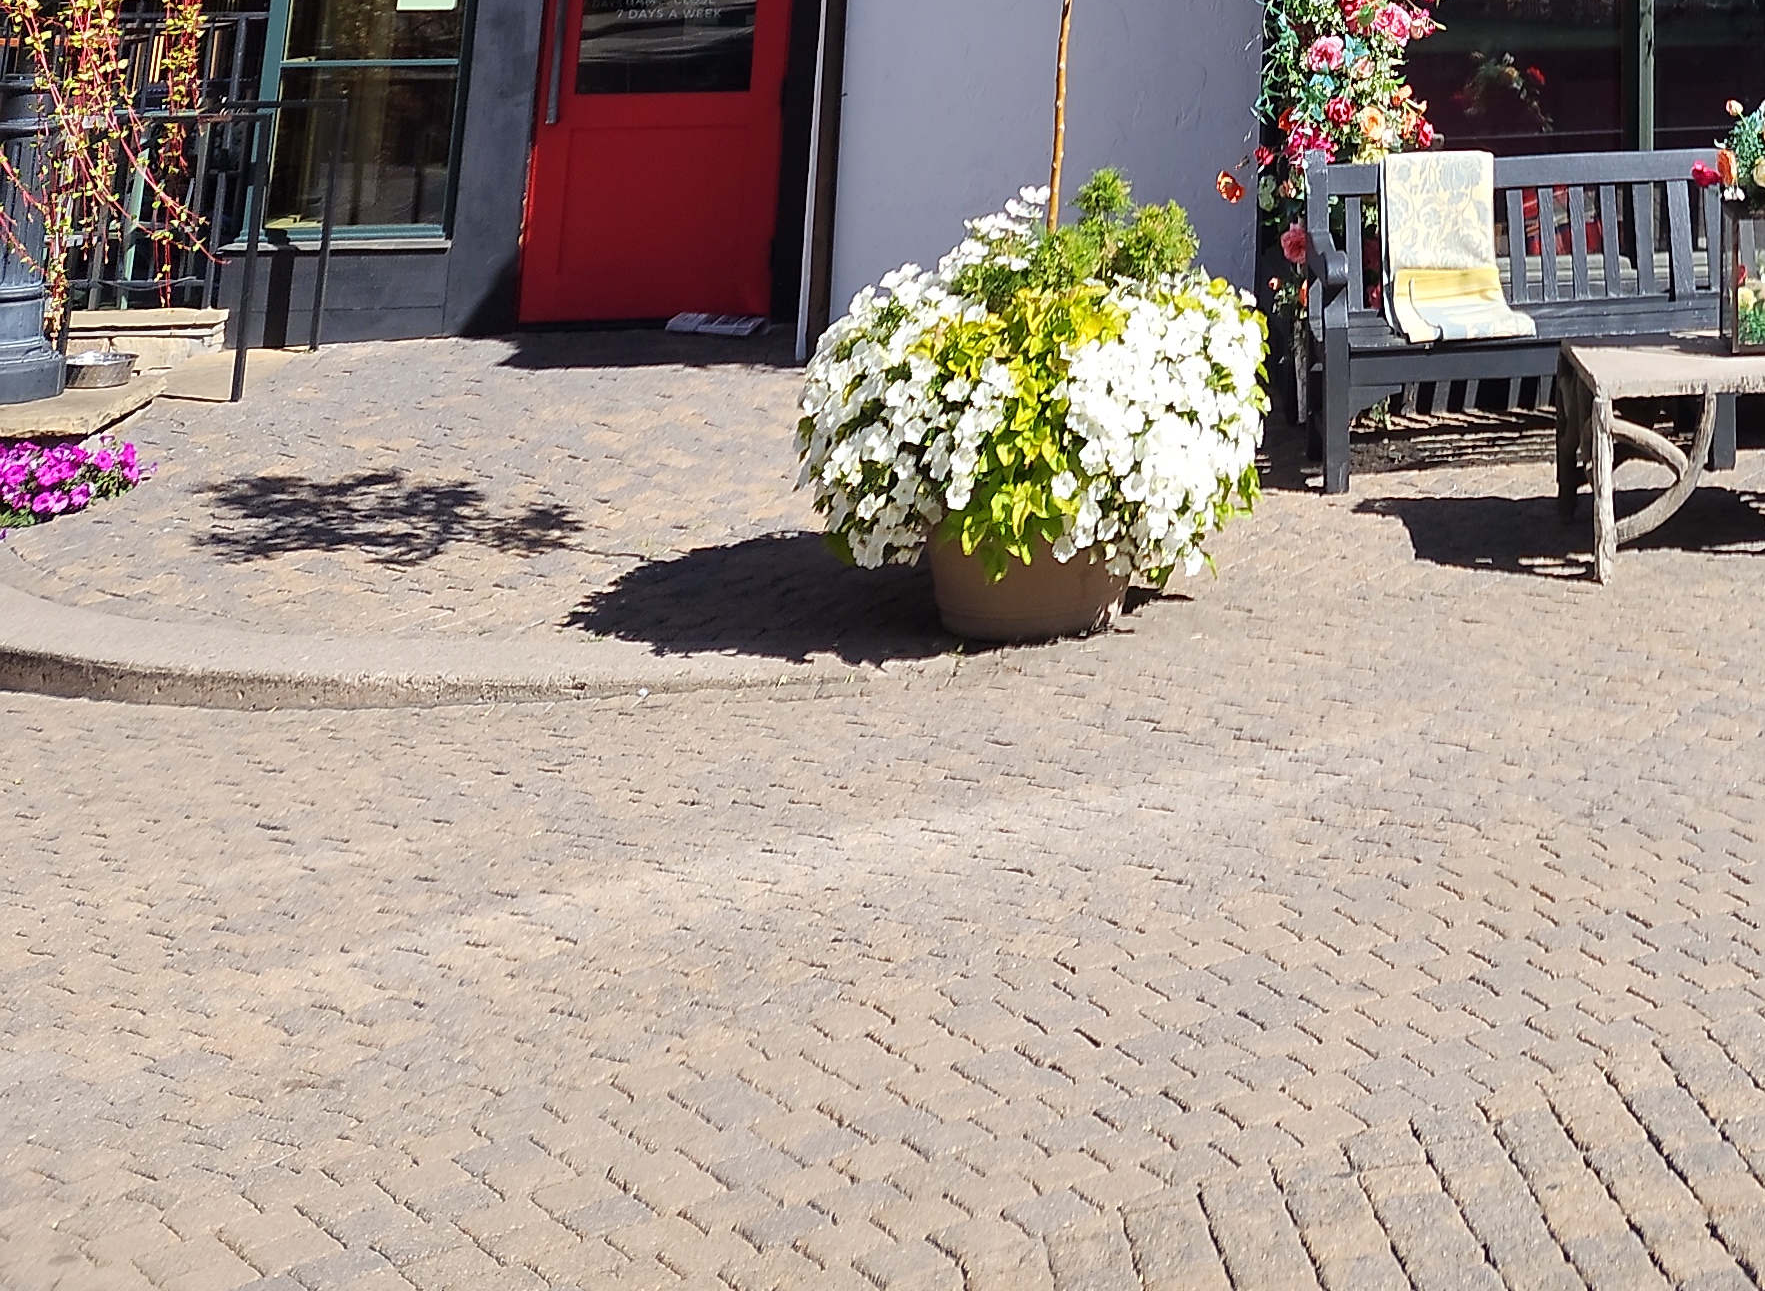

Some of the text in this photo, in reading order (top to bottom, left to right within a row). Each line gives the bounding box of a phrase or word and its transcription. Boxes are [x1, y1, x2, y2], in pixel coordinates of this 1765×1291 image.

[628, 8, 664, 19] DAYS
[668, 9, 678, 19] A
[682, 8, 722, 19] WEEK
